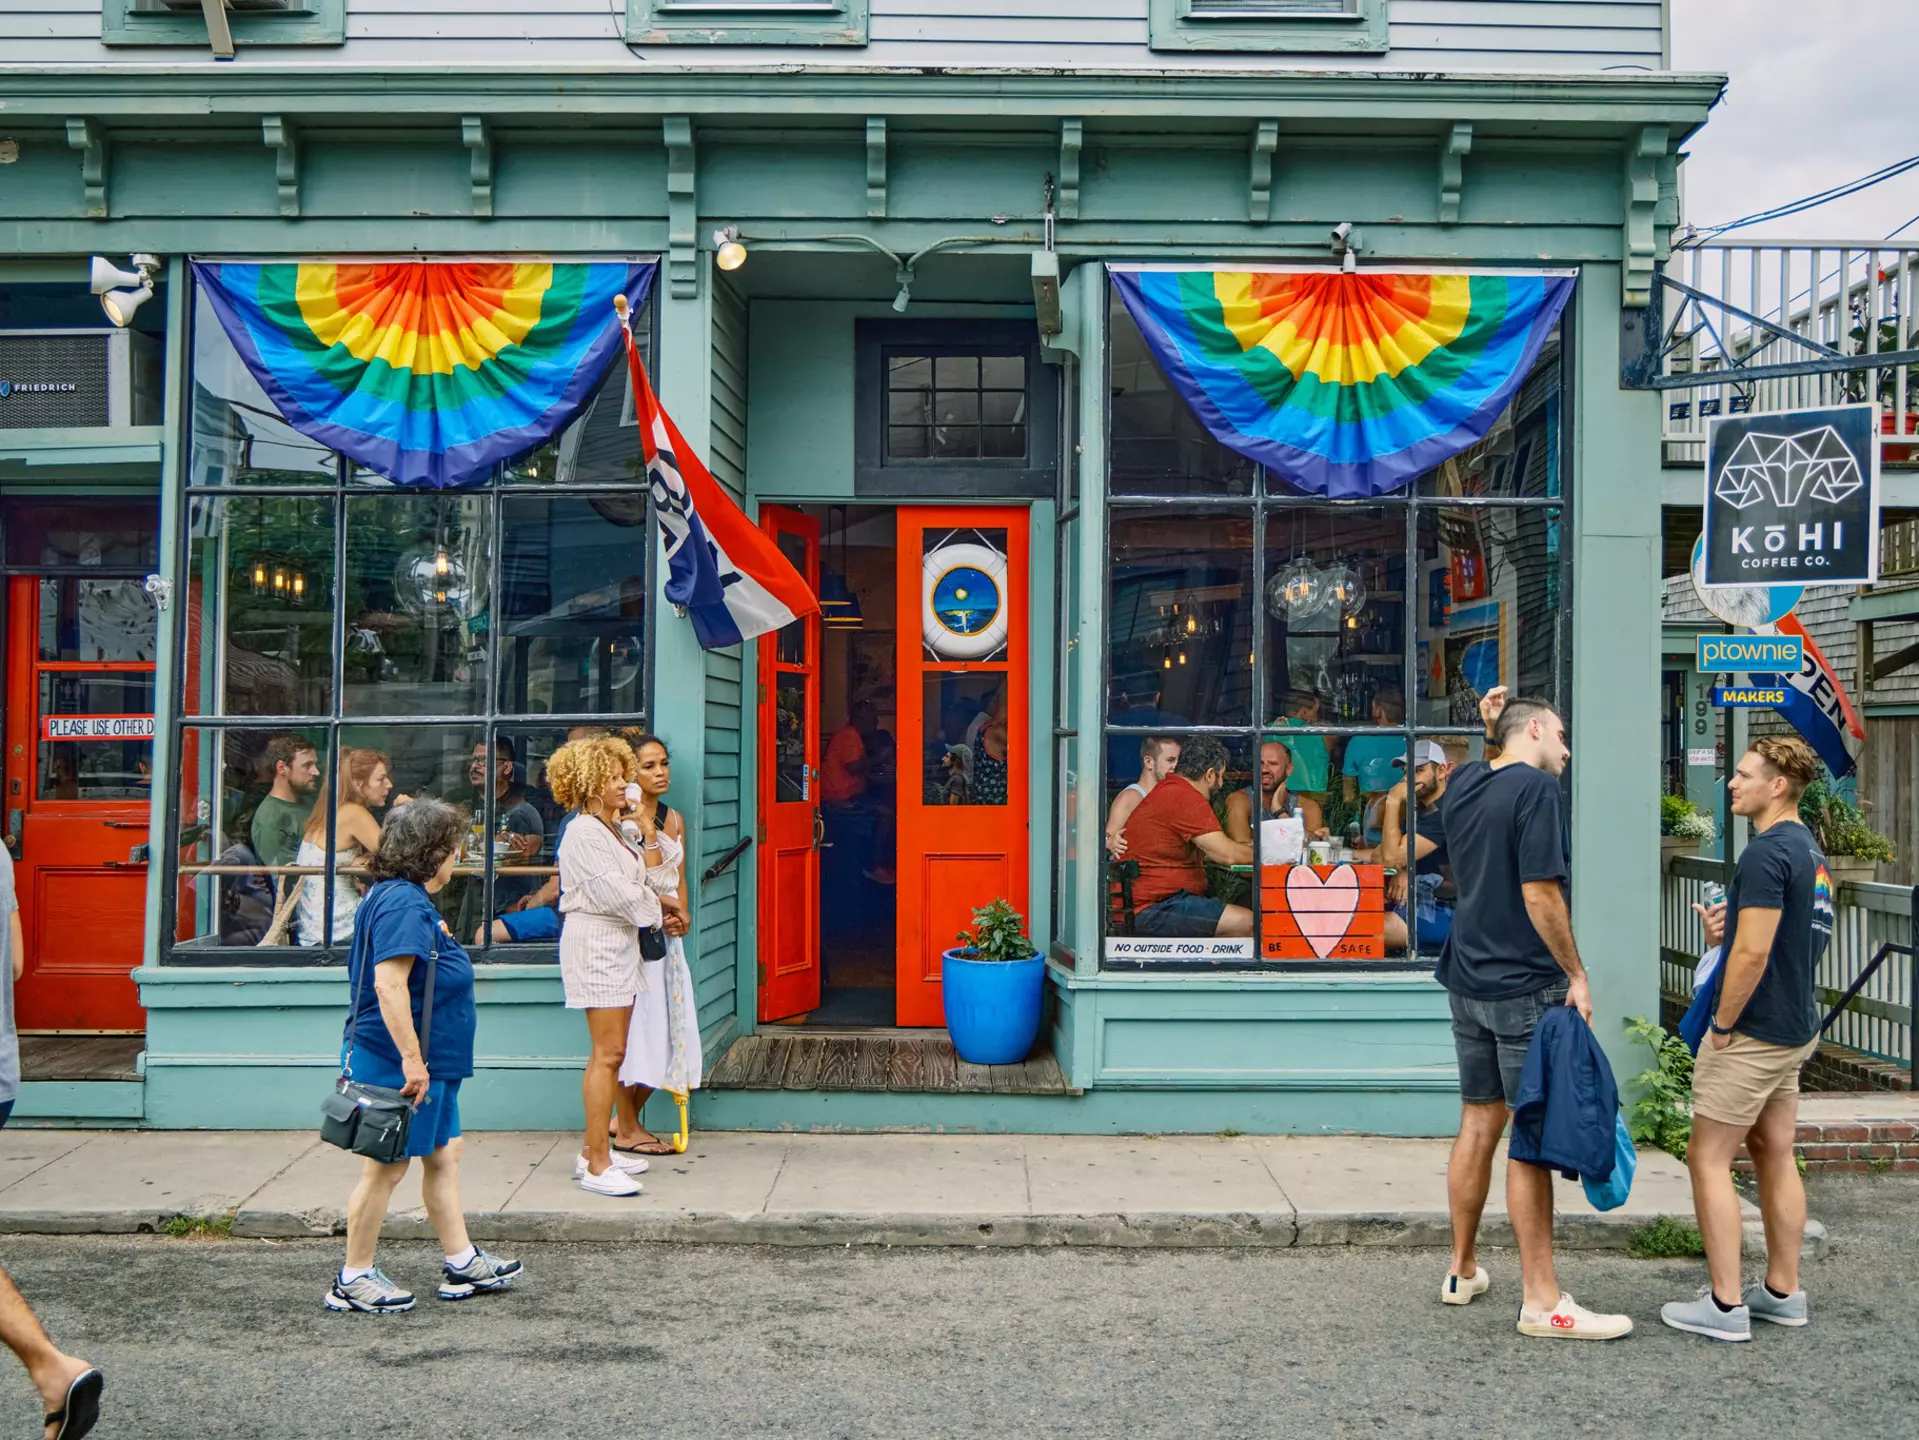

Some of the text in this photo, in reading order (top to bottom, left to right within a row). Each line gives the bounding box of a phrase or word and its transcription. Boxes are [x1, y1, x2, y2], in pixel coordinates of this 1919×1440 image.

[14, 383, 76, 392] FRIEDRICH
[1741, 555, 1830, 569] COFFEE CO.
[1703, 640, 1798, 667] ptownie
[1723, 690, 1785, 703] MAKERS
[1785, 653, 1846, 731] PEN
[50, 719, 154, 736] PLEASE USE OTHER D
[1114, 943, 1132, 952] NO
[1133, 944, 1173, 953] OUTSIDE
[1176, 944, 1204, 954] FOOD
[1211, 944, 1244, 954] DRINK
[1268, 942, 1372, 954] BE SAFE
